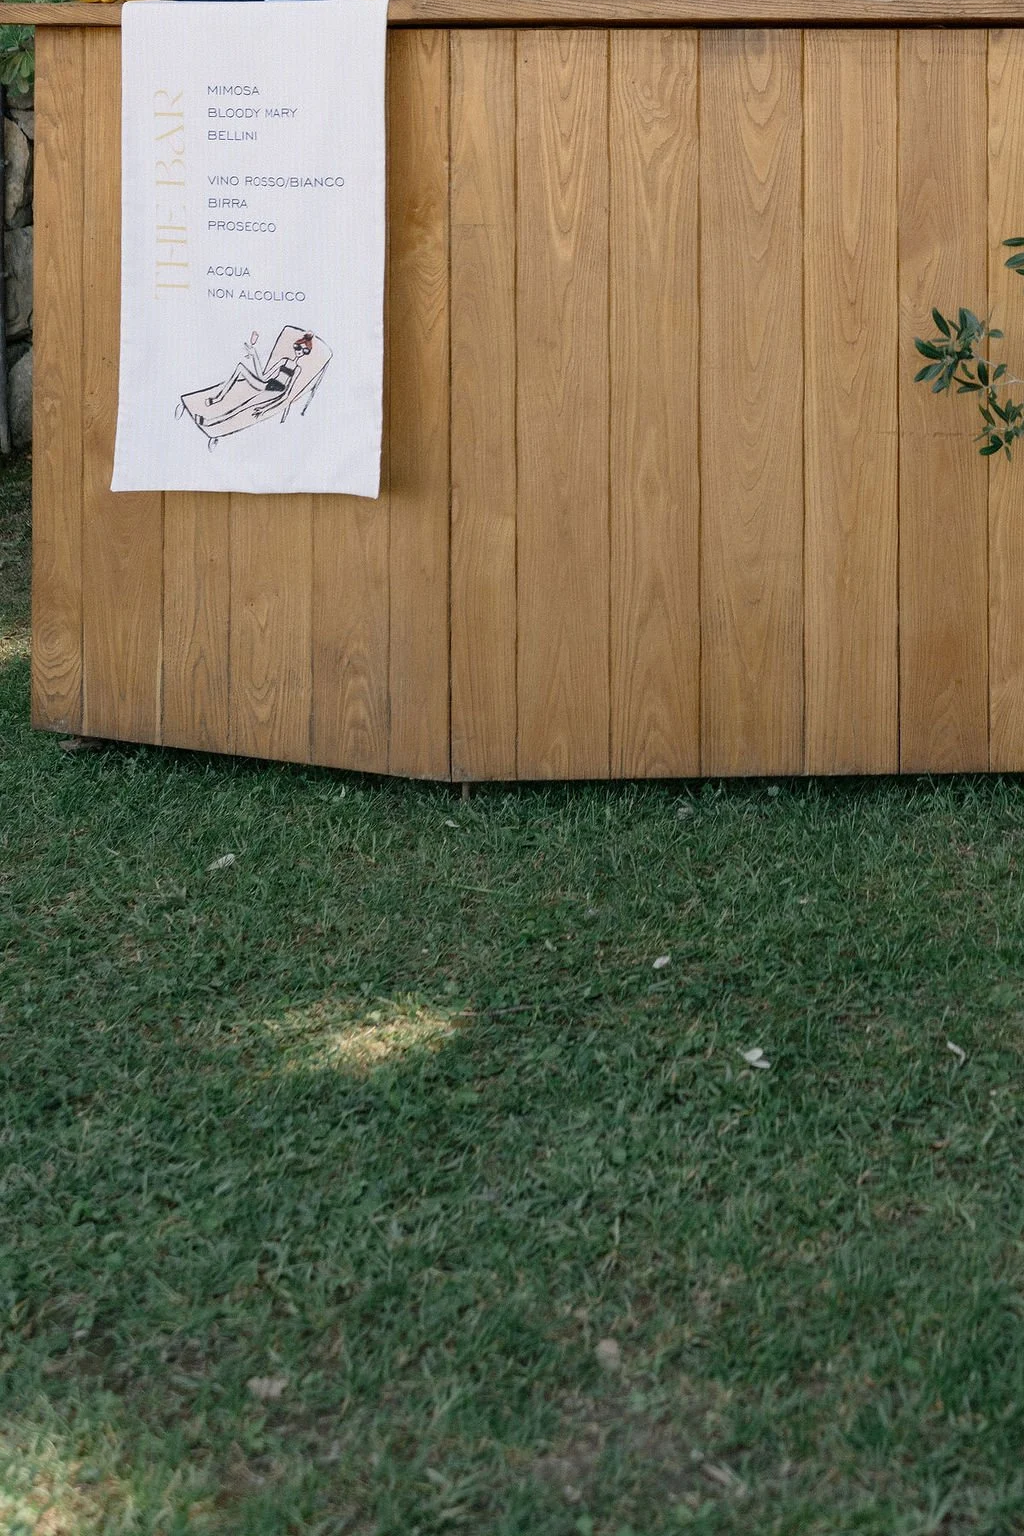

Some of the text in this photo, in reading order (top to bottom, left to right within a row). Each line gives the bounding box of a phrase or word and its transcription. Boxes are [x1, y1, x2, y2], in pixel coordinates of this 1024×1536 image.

[207, 85, 260, 96] MIMOSA
[207, 108, 298, 118] BLOODY MARY
[207, 130, 258, 141] BELLINI
[207, 175, 345, 189] VINO ROSSO/BIANCO
[154, 89, 188, 300] THE BAR
[207, 197, 248, 209] BIRRA
[207, 220, 277, 233] PROSECCO
[206, 266, 251, 277] ACQUA
[207, 288, 306, 302] NON ALCOLICO
